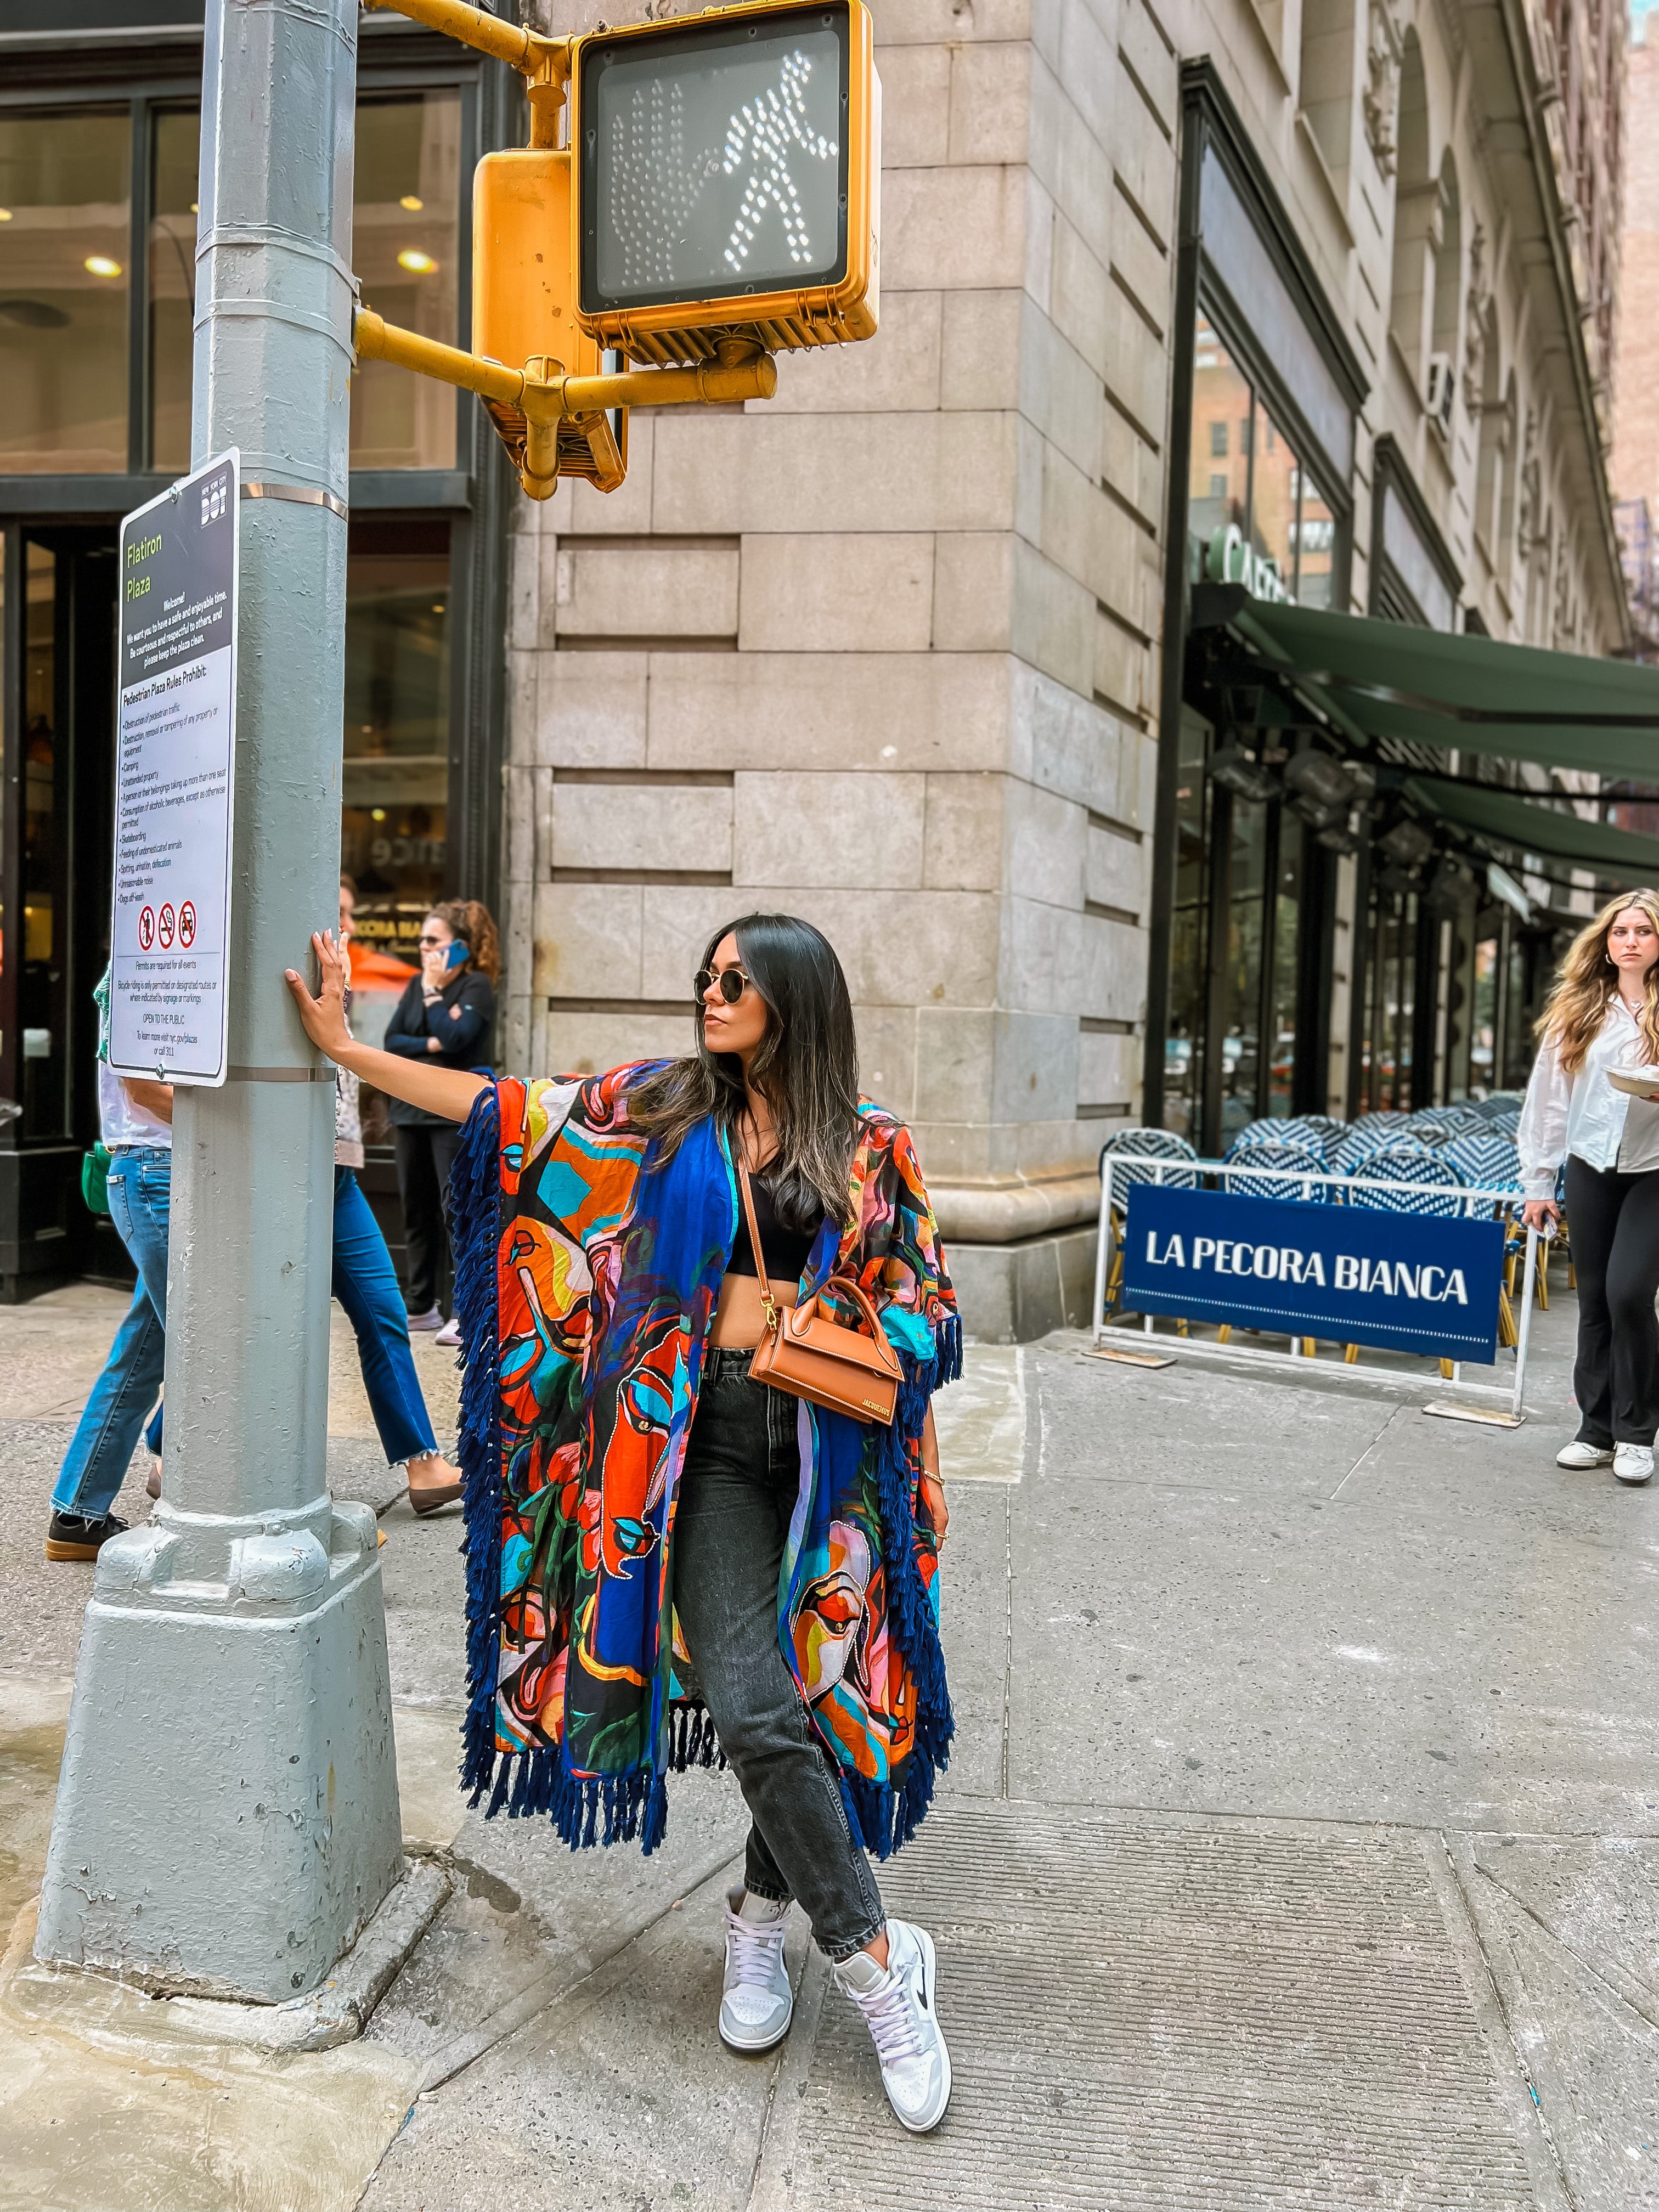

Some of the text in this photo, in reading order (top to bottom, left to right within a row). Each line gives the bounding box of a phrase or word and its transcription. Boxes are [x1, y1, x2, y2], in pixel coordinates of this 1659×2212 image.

[201, 486, 227, 525] DOT
[127, 534, 162, 568] Flatiron
[127, 575, 151, 602] Plaza
[163, 591, 185, 612] Welcome!
[127, 634, 133, 645] We
[134, 629, 144, 642] want
[153, 624, 157, 633] to
[157, 619, 168, 631] have
[168, 617, 171, 626] a
[172, 610, 182, 624] safe
[182, 605, 191, 619] and
[192, 595, 213, 615] enjoyable
[215, 591, 227, 603] time.
[130, 648, 136, 659] Be
[137, 640, 157, 656] courteous
[166, 622, 189, 642] respectful
[190, 622, 195, 632] to
[196, 615, 212, 629] others,
[213, 607, 223, 622] and
[144, 654, 159, 669] please
[159, 650, 169, 661] keep
[178, 640, 190, 654] plaza
[191, 634, 205, 647] clean.
[124, 664, 207, 707] Pedestrian Plaza Rules Prohibit:
[145, 712, 149, 724] of
[124, 761, 138, 772] Camping
[143, 1013, 185, 1025] OPEN TO THE PUBLIC
[166, 1046, 174, 1057] 311
[1146, 1231, 1468, 1305] LA PECORA BIANCA
[861, 1398, 890, 1417] JACQUEMUS
